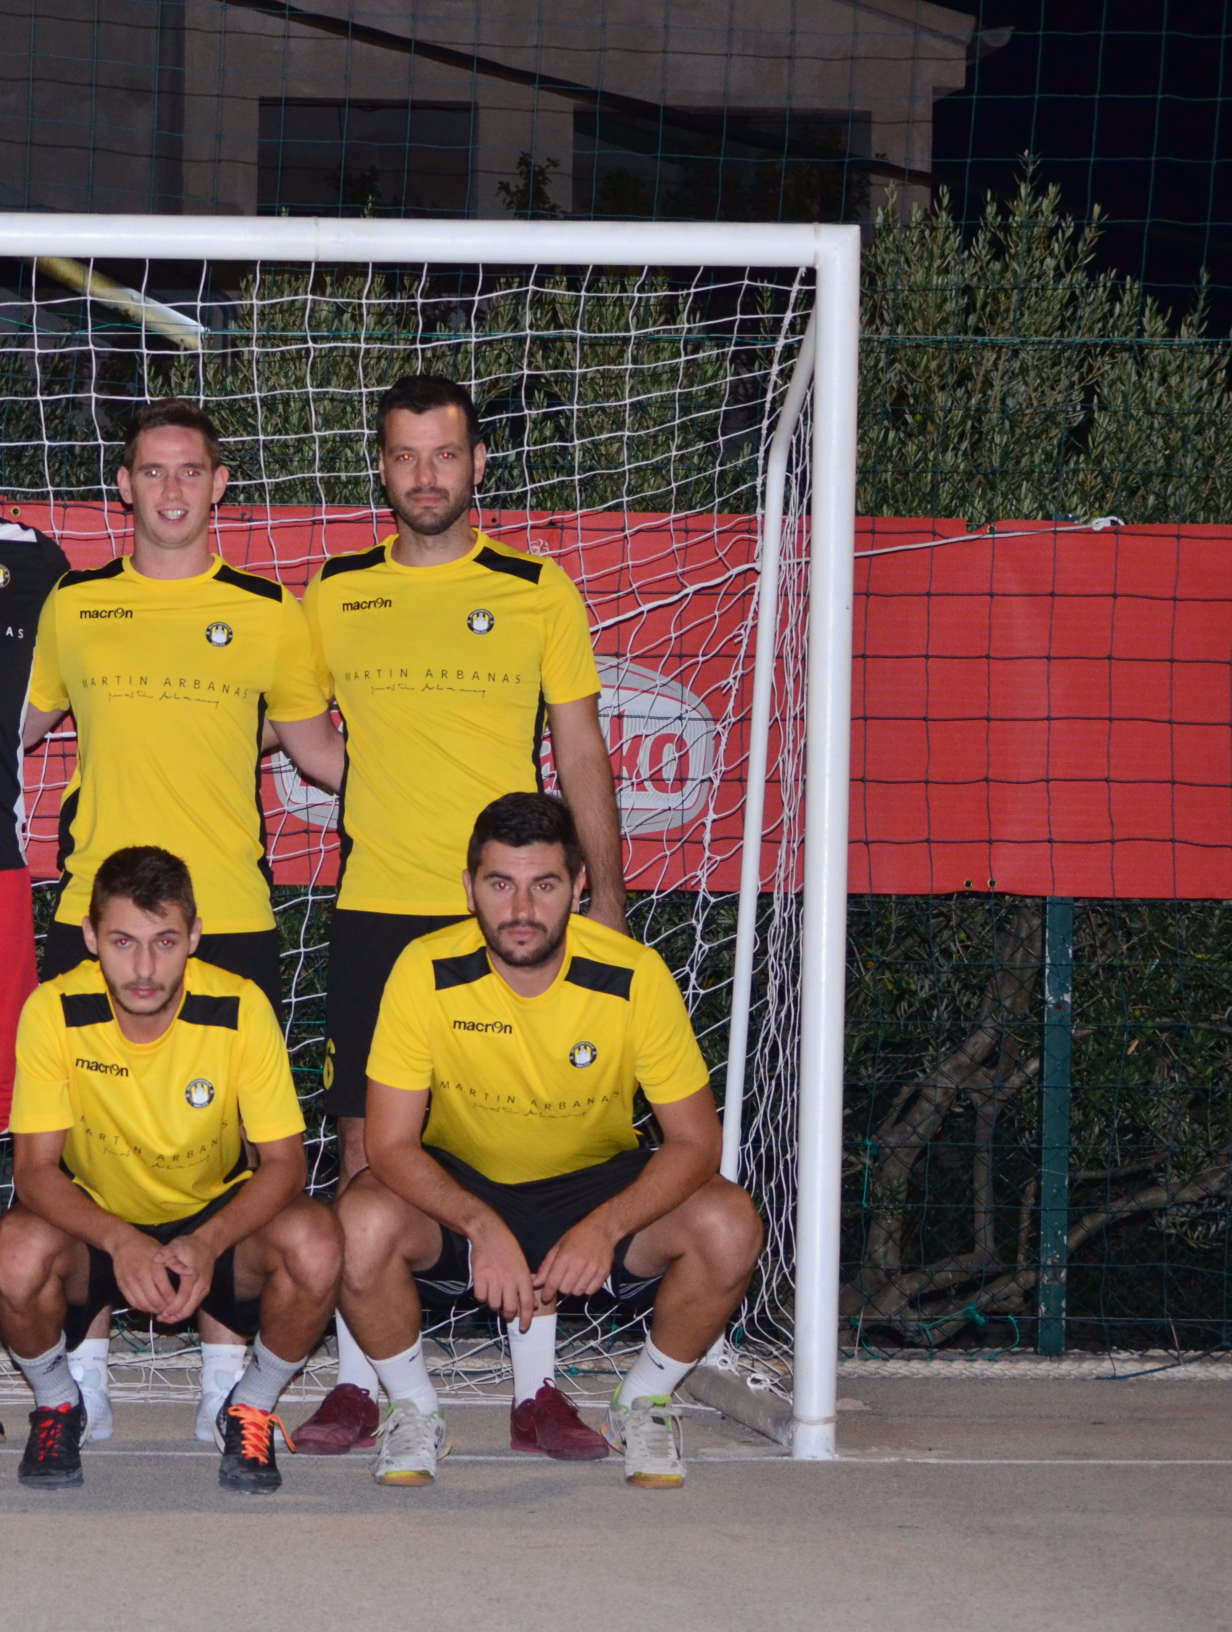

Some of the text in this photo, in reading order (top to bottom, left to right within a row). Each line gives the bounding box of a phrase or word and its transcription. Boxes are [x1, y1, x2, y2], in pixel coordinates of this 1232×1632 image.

[342, 597, 393, 612] macron
[79, 607, 134, 620] macron
[425, 668, 521, 684] ARBANAS
[163, 676, 249, 700] ARBANAS
[452, 1018, 513, 1035] macron
[75, 1056, 129, 1078] macron
[439, 1079, 516, 1104] MARTIN
